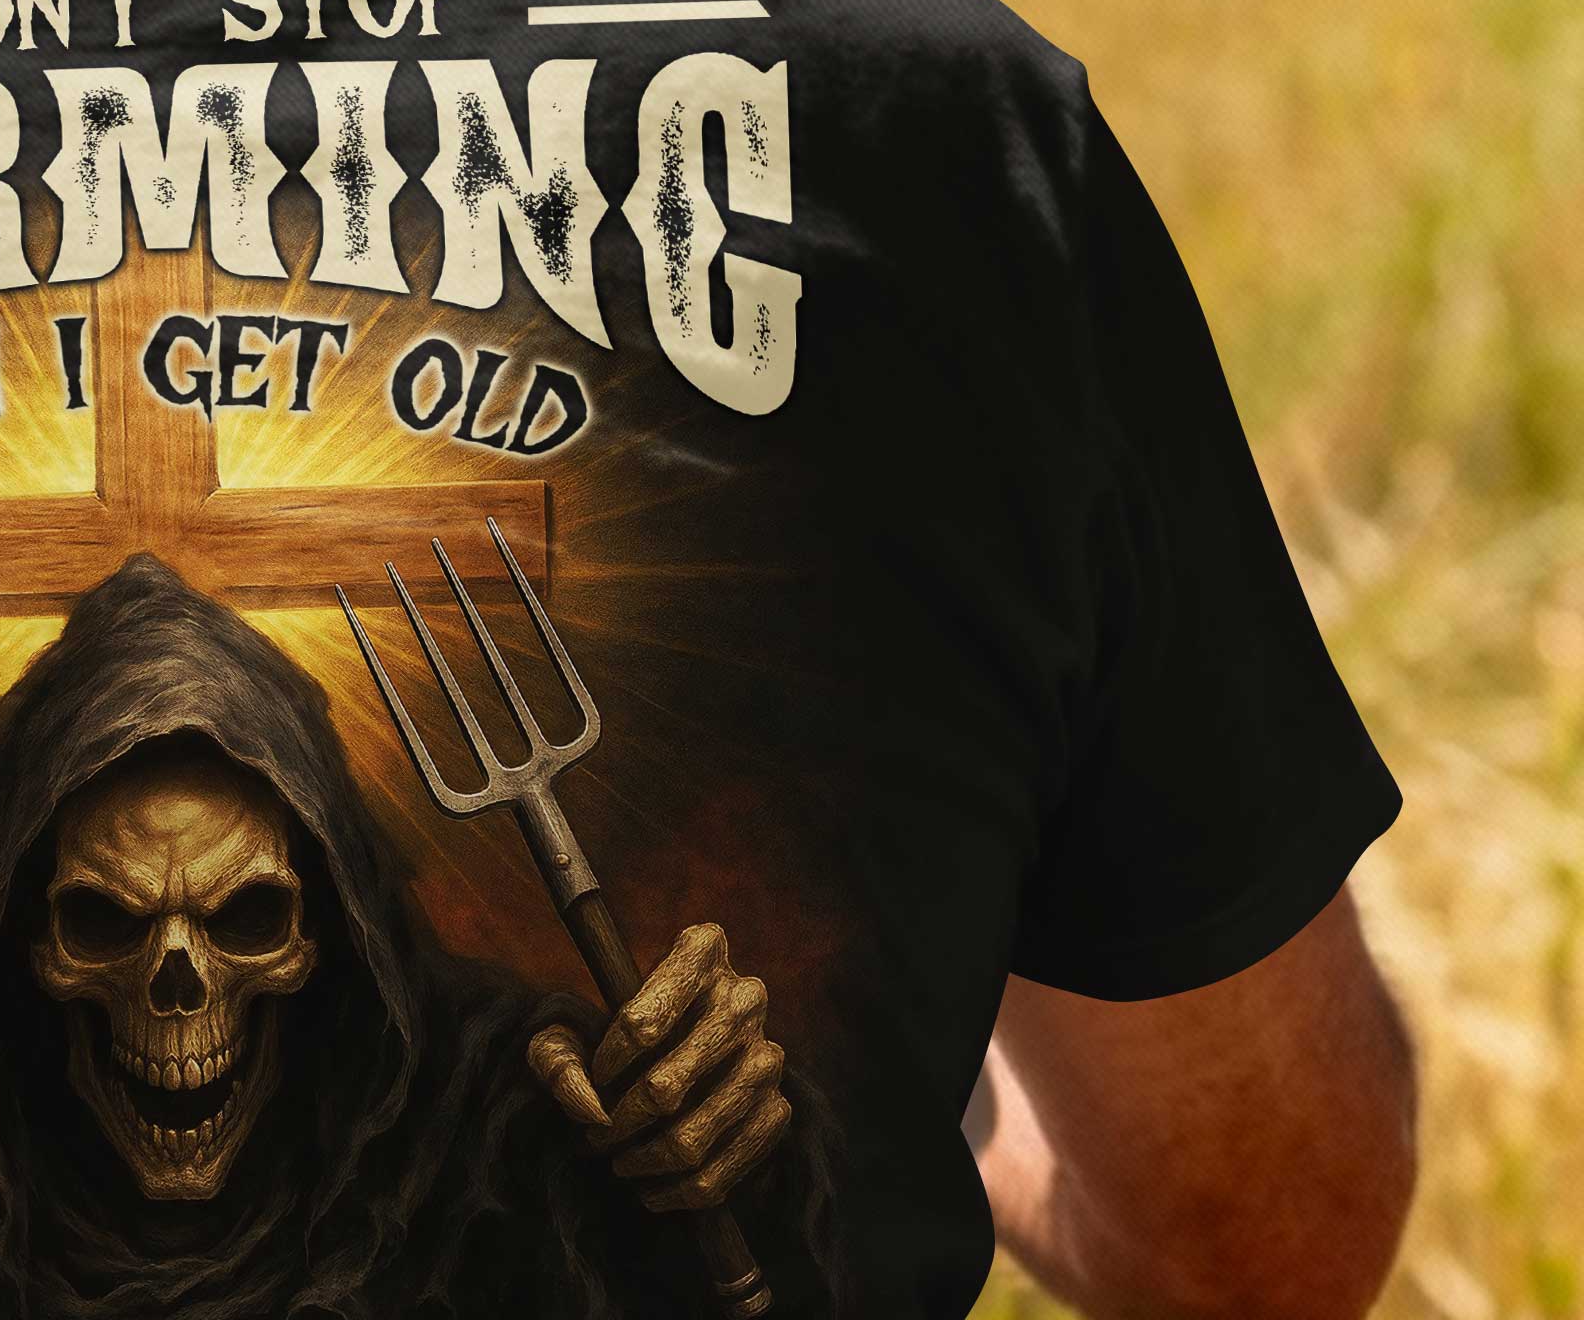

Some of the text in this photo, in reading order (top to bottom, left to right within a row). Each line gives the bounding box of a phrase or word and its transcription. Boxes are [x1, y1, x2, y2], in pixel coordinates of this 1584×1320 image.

[54, 317, 89, 410] I
[143, 315, 349, 423] GET
[391, 338, 588, 455] OLD
